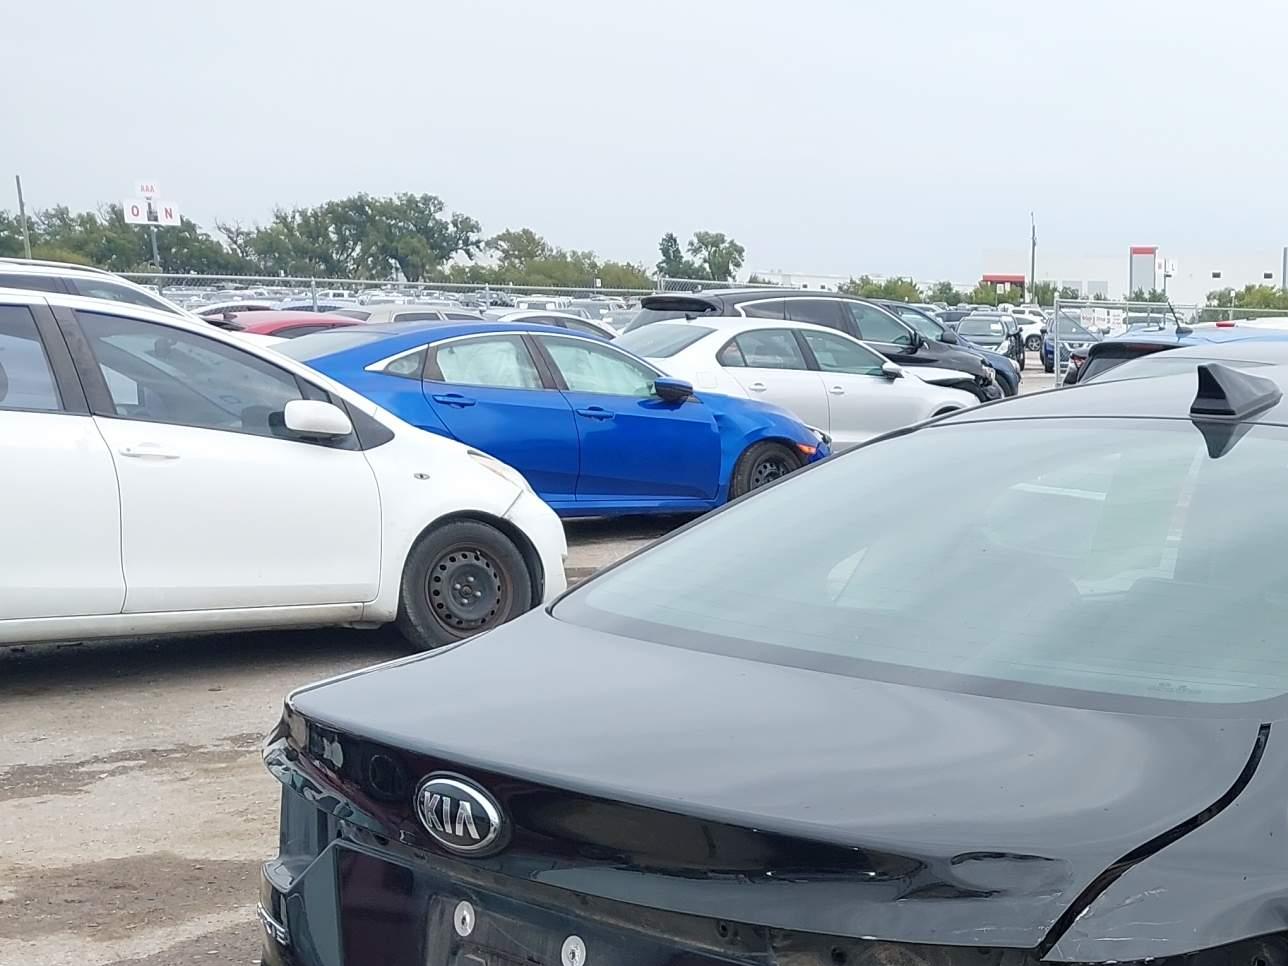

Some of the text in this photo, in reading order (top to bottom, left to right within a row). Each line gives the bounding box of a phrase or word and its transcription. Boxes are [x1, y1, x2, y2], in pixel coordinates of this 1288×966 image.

[131, 204, 140, 217] O
[164, 207, 173, 219] N
[423, 791, 481, 840] KIA
